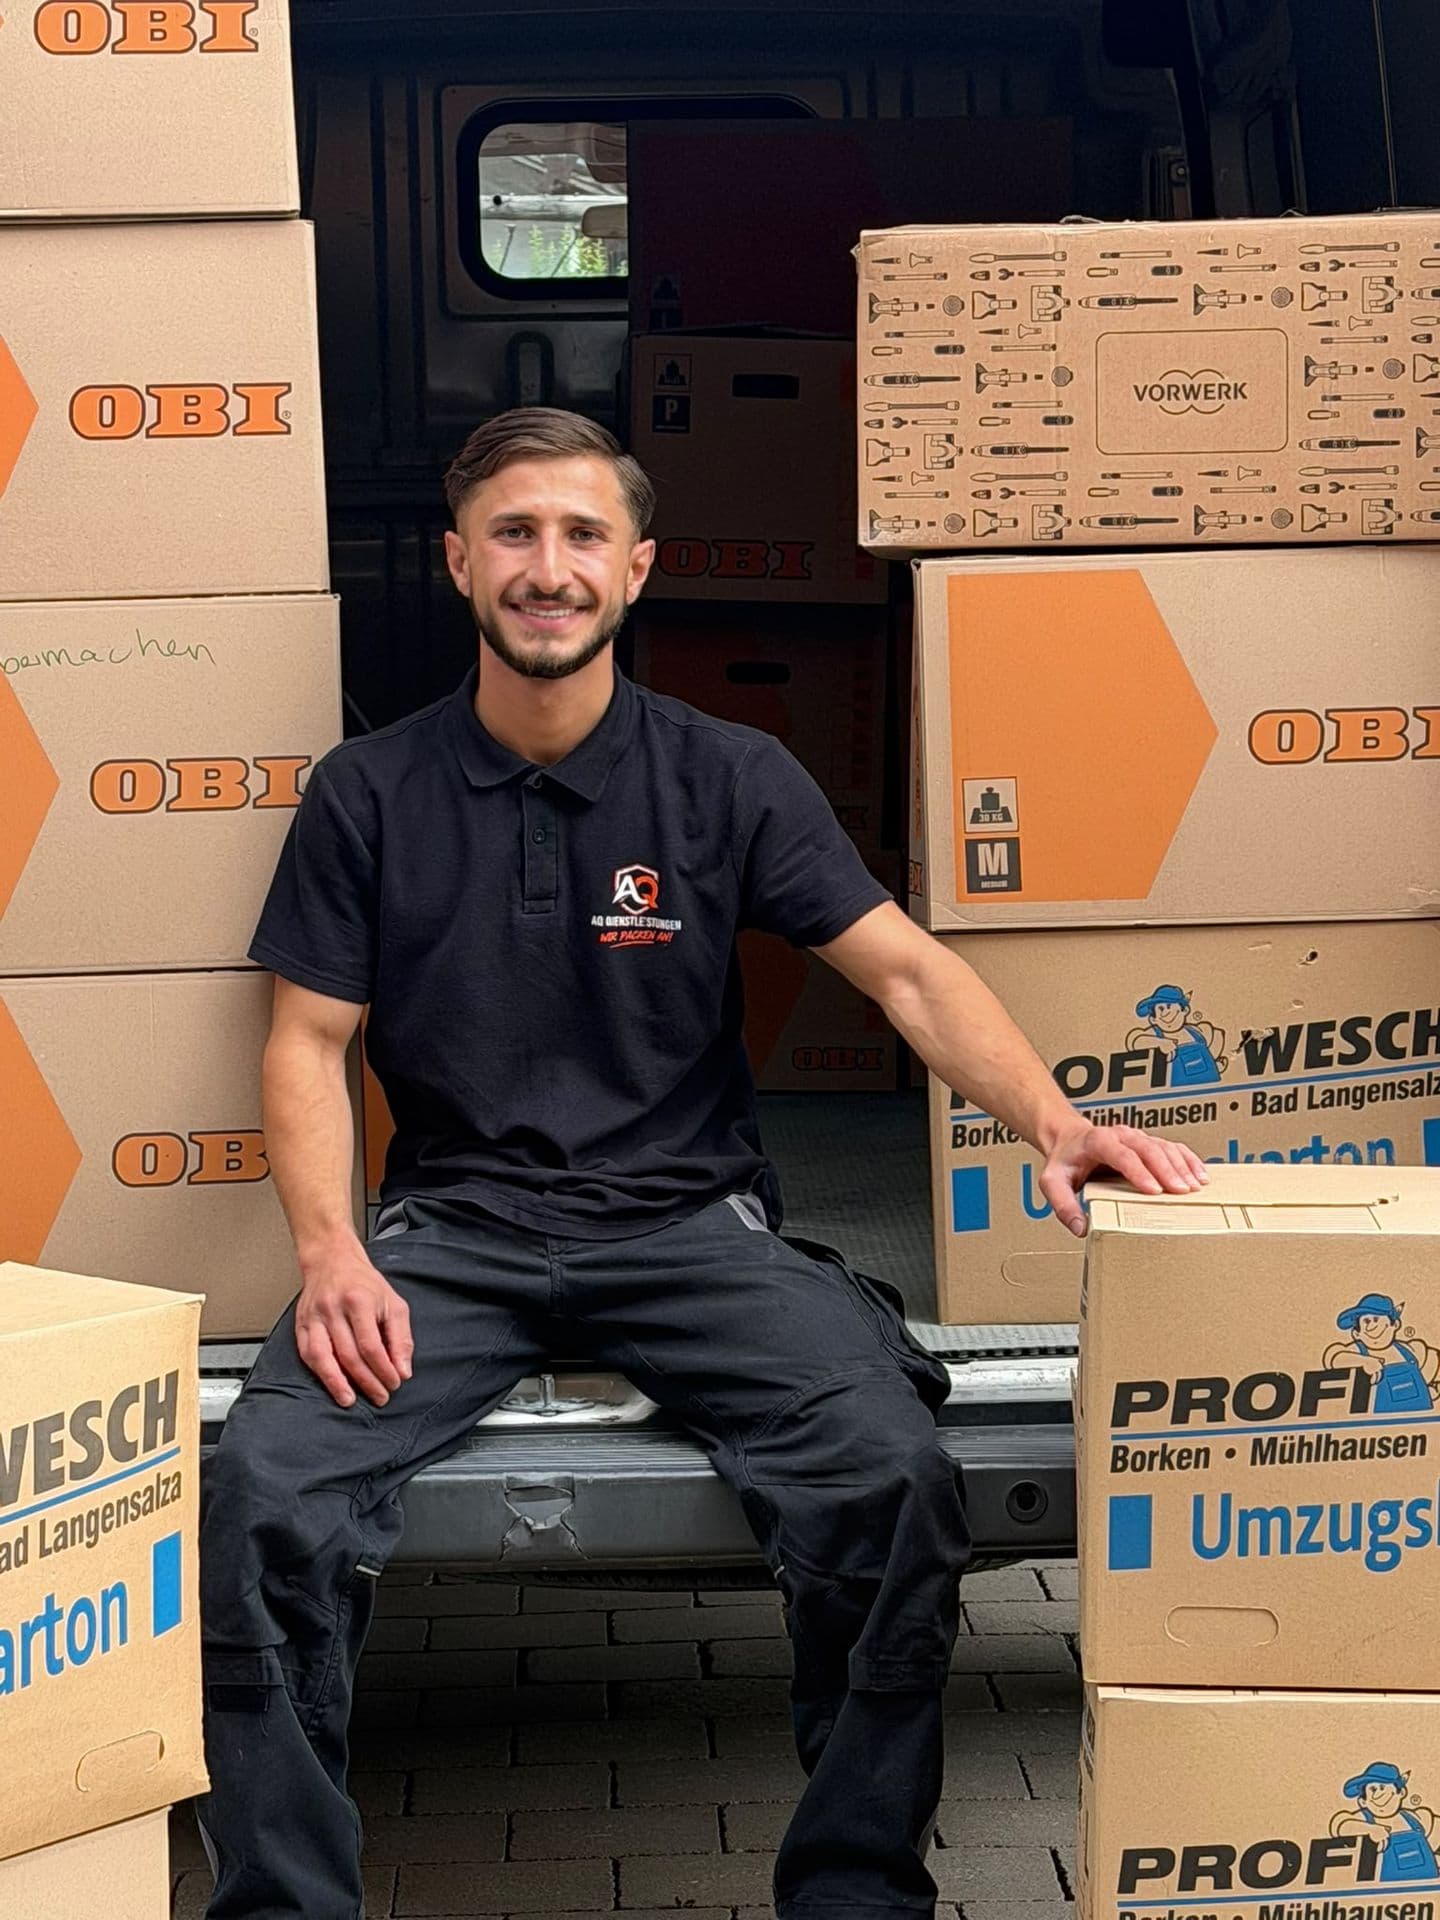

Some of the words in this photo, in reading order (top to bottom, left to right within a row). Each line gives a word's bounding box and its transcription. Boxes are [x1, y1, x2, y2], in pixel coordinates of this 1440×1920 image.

[34, 0, 259, 54] OBI
[69, 382, 292, 440] OBI
[1133, 382, 1248, 402] VORWERK
[657, 538, 814, 581] OBI
[90, 755, 312, 814] OBI
[977, 842, 1009, 877] M
[612, 874, 658, 909] AQ
[1251, 1087, 1298, 1117] Bad
[112, 1130, 271, 1187] OB
[1110, 1367, 1374, 1428] PROFI
[1110, 1443, 1210, 1473] Borken
[1250, 1433, 1427, 1466] Mühlhausen
[39, 1470, 181, 1559] Langensalza
[1192, 1480, 1440, 1572] Umzugs
[1117, 1834, 1378, 1894] PROFI
